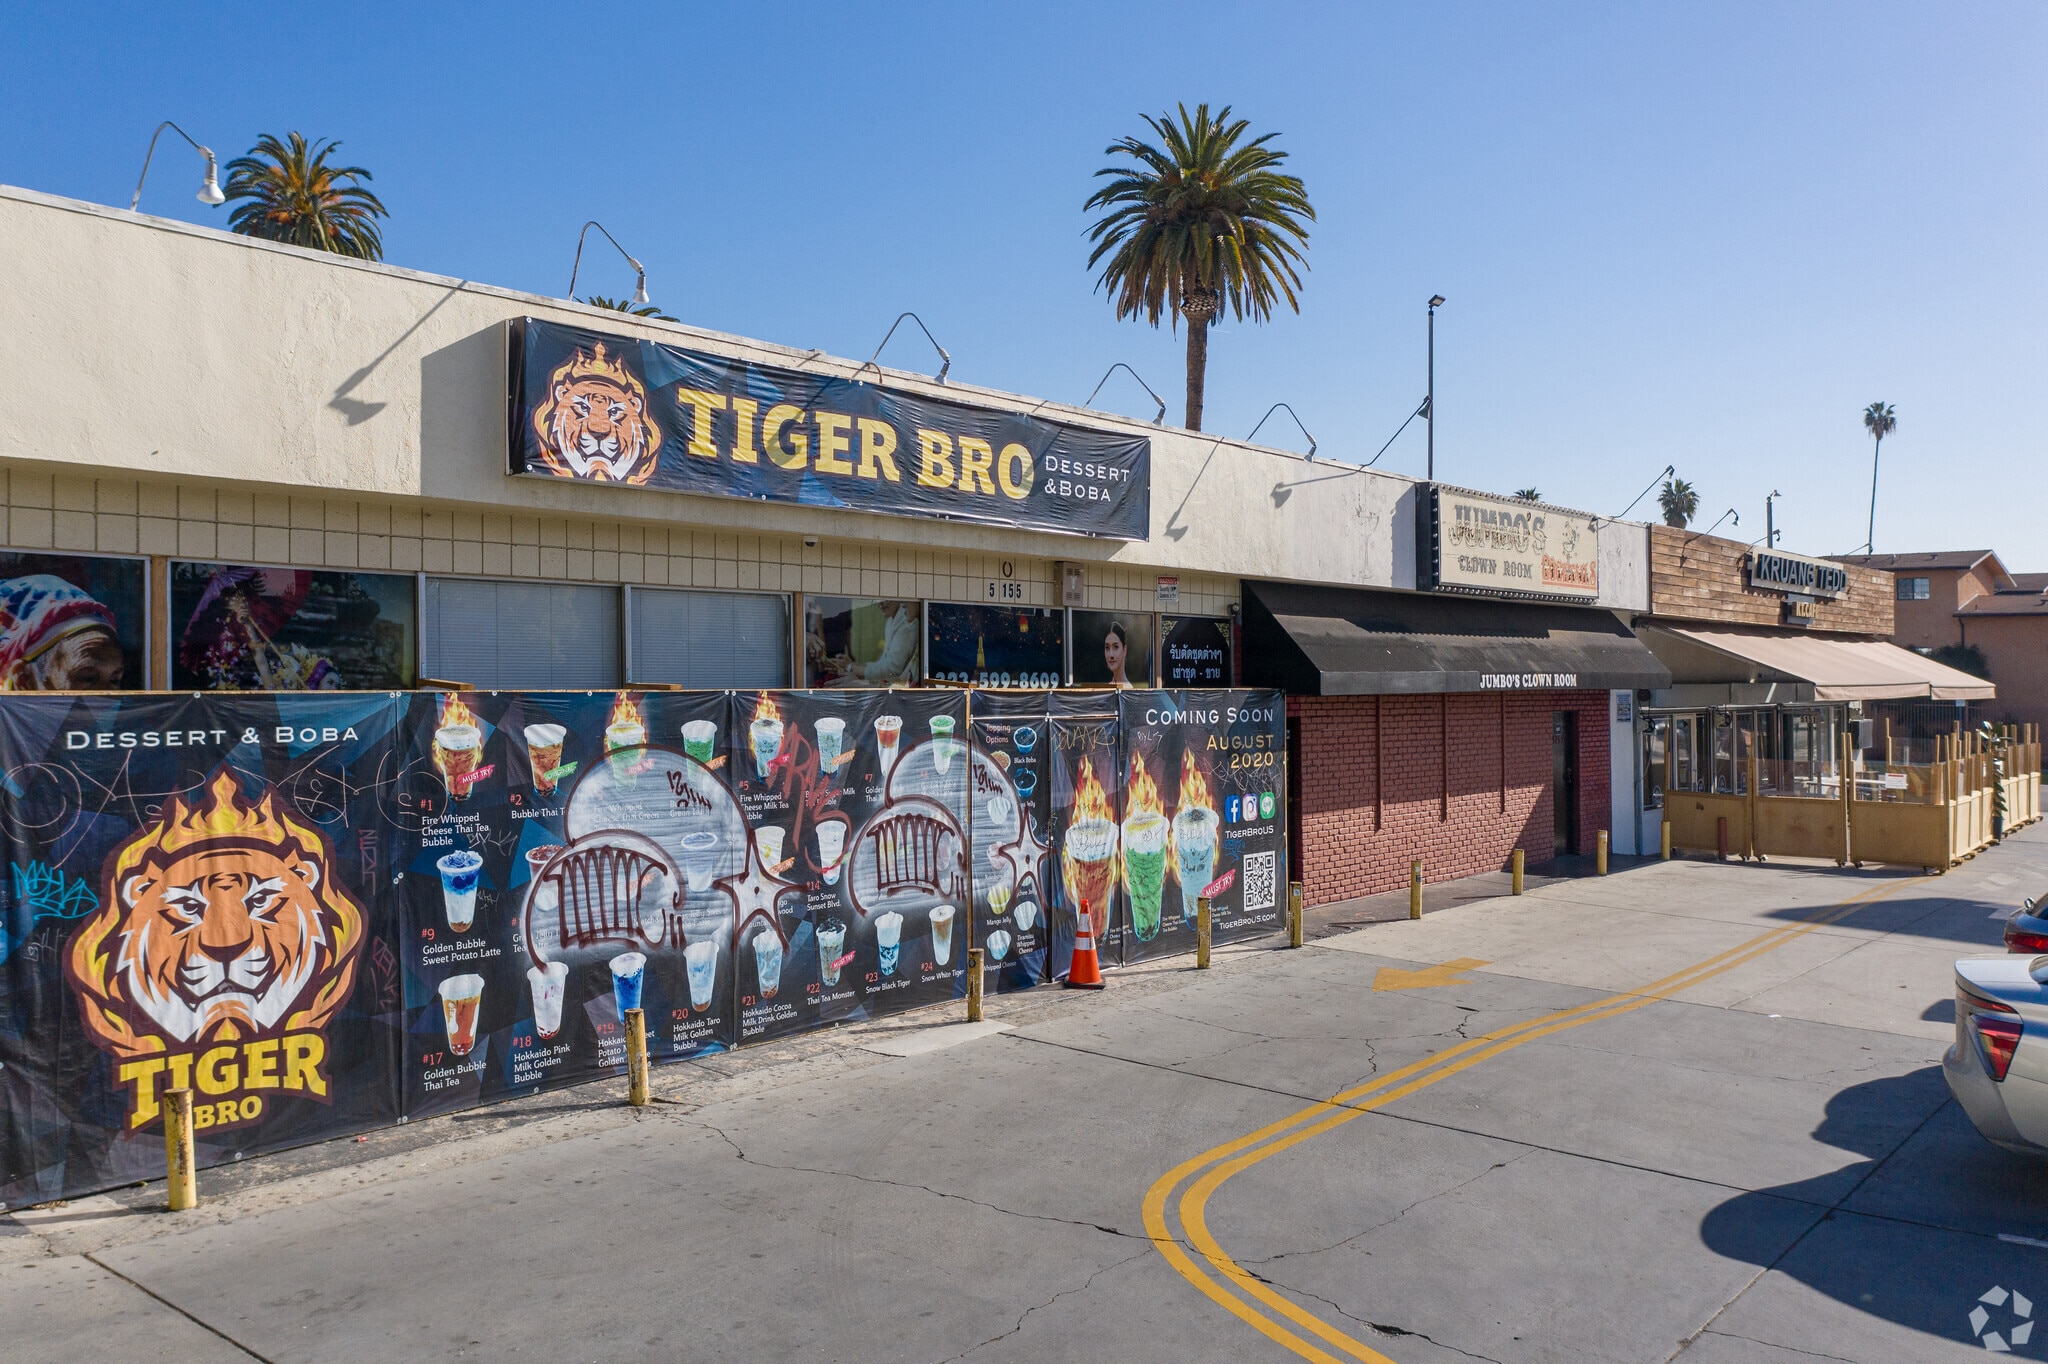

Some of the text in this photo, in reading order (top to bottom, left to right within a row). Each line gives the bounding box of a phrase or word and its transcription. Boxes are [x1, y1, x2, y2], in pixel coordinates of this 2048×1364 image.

[677, 387, 1036, 501] TIGER BRO
[1045, 456, 1131, 483] DESSERT
[1044, 479, 1112, 503] &BOBA
[1448, 504, 1548, 556] JUMBO'S
[1457, 554, 1533, 580] CLOWN ROOM
[1757, 553, 1848, 592] KRUANG TEDD
[1480, 673, 1577, 689] JUMBO'S CLOWN ROOM
[1145, 707, 1274, 726] COMING SOON
[985, 723, 1011, 734] Topping
[66, 726, 359, 750] DESSERT & BOBA
[985, 735, 1009, 745] Options
[1206, 733, 1275, 751] AUGUST
[1230, 751, 1275, 769] 2020
[462, 768, 491, 784] MUST TRY
[864, 773, 873, 783] #7
[739, 780, 749, 791] #5
[842, 788, 856, 796] Milk
[420, 799, 433, 811] #1
[509, 794, 522, 806] #2
[740, 792, 782, 804] Fire Whipped
[763, 801, 778, 810] Milk
[779, 801, 789, 809] Tea
[422, 812, 480, 826] Fire Whipped
[511, 809, 539, 819] Bubble
[541, 808, 558, 816] Thai
[421, 823, 490, 837] Cheese Thai Tea
[422, 836, 453, 847] Bubble
[806, 880, 821, 891] #14
[1205, 874, 1233, 897] MUST TRY
[807, 892, 836, 902] Taro Snow
[806, 903, 826, 911] Sunset
[986, 916, 1012, 926] Mango Jelly
[421, 928, 435, 941] #9
[422, 938, 486, 955] Golden Bubble
[513, 944, 527, 953] Tea
[1016, 939, 1036, 948] Whipped
[422, 947, 501, 966] Sweet Potato Latte
[1018, 947, 1034, 956] Cheese
[833, 954, 855, 968] MUST TRY
[921, 961, 933, 972] #24
[1002, 960, 1017, 968] Cheese
[865, 972, 879, 983] #23
[921, 967, 965, 983] Snow White Tiger
[806, 982, 821, 994] #22
[865, 978, 911, 994] Snow Black Tiger
[741, 995, 756, 1006] #21
[807, 990, 856, 1006] Thai Tea Monster
[671, 1007, 689, 1020] #20
[742, 1003, 792, 1019] Hokkaido Cocoa
[673, 1017, 721, 1033] Hokkaido Taro
[742, 1010, 798, 1028] Milk Drink Golden
[596, 1023, 615, 1035] #19
[673, 1027, 714, 1043] Milk Golden
[742, 1026, 765, 1037] Bubble
[512, 1035, 532, 1049] #18
[673, 1040, 698, 1052] Bubble
[421, 1052, 443, 1067] #17
[514, 1043, 571, 1063] Hokkaido Pink
[598, 1047, 621, 1058] Potato
[514, 1056, 562, 1073] Milk Golden
[598, 1056, 625, 1068] Golden
[423, 1061, 487, 1081] Golden Bubble
[514, 1071, 543, 1084] Bubble
[119, 1033, 327, 1130] TIGER
[423, 1077, 460, 1092] Thai Tea
[194, 1095, 263, 1130] BRO
